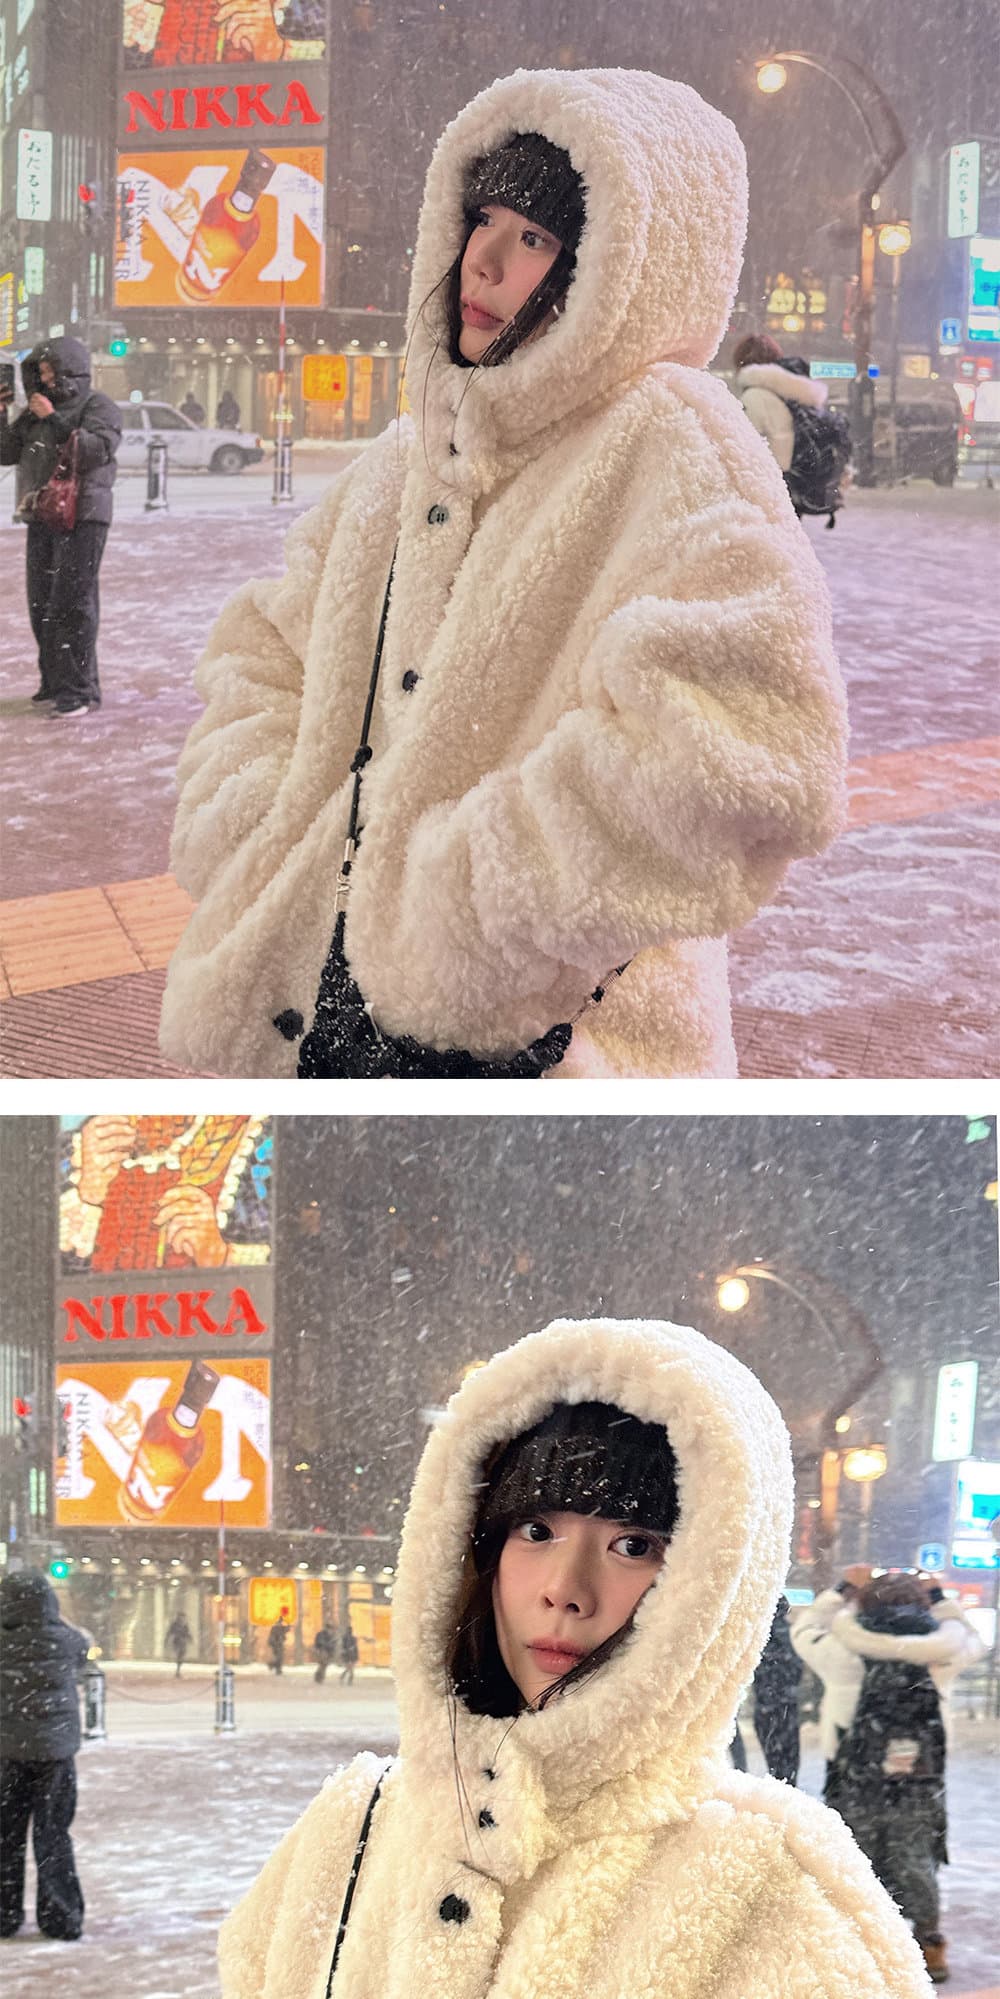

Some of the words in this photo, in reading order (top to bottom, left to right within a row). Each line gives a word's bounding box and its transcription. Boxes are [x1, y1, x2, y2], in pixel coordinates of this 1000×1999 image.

[124, 80, 322, 132] NIKKA
[136, 180, 150, 246] NIKKA
[62, 1288, 267, 1342] NIKKA
